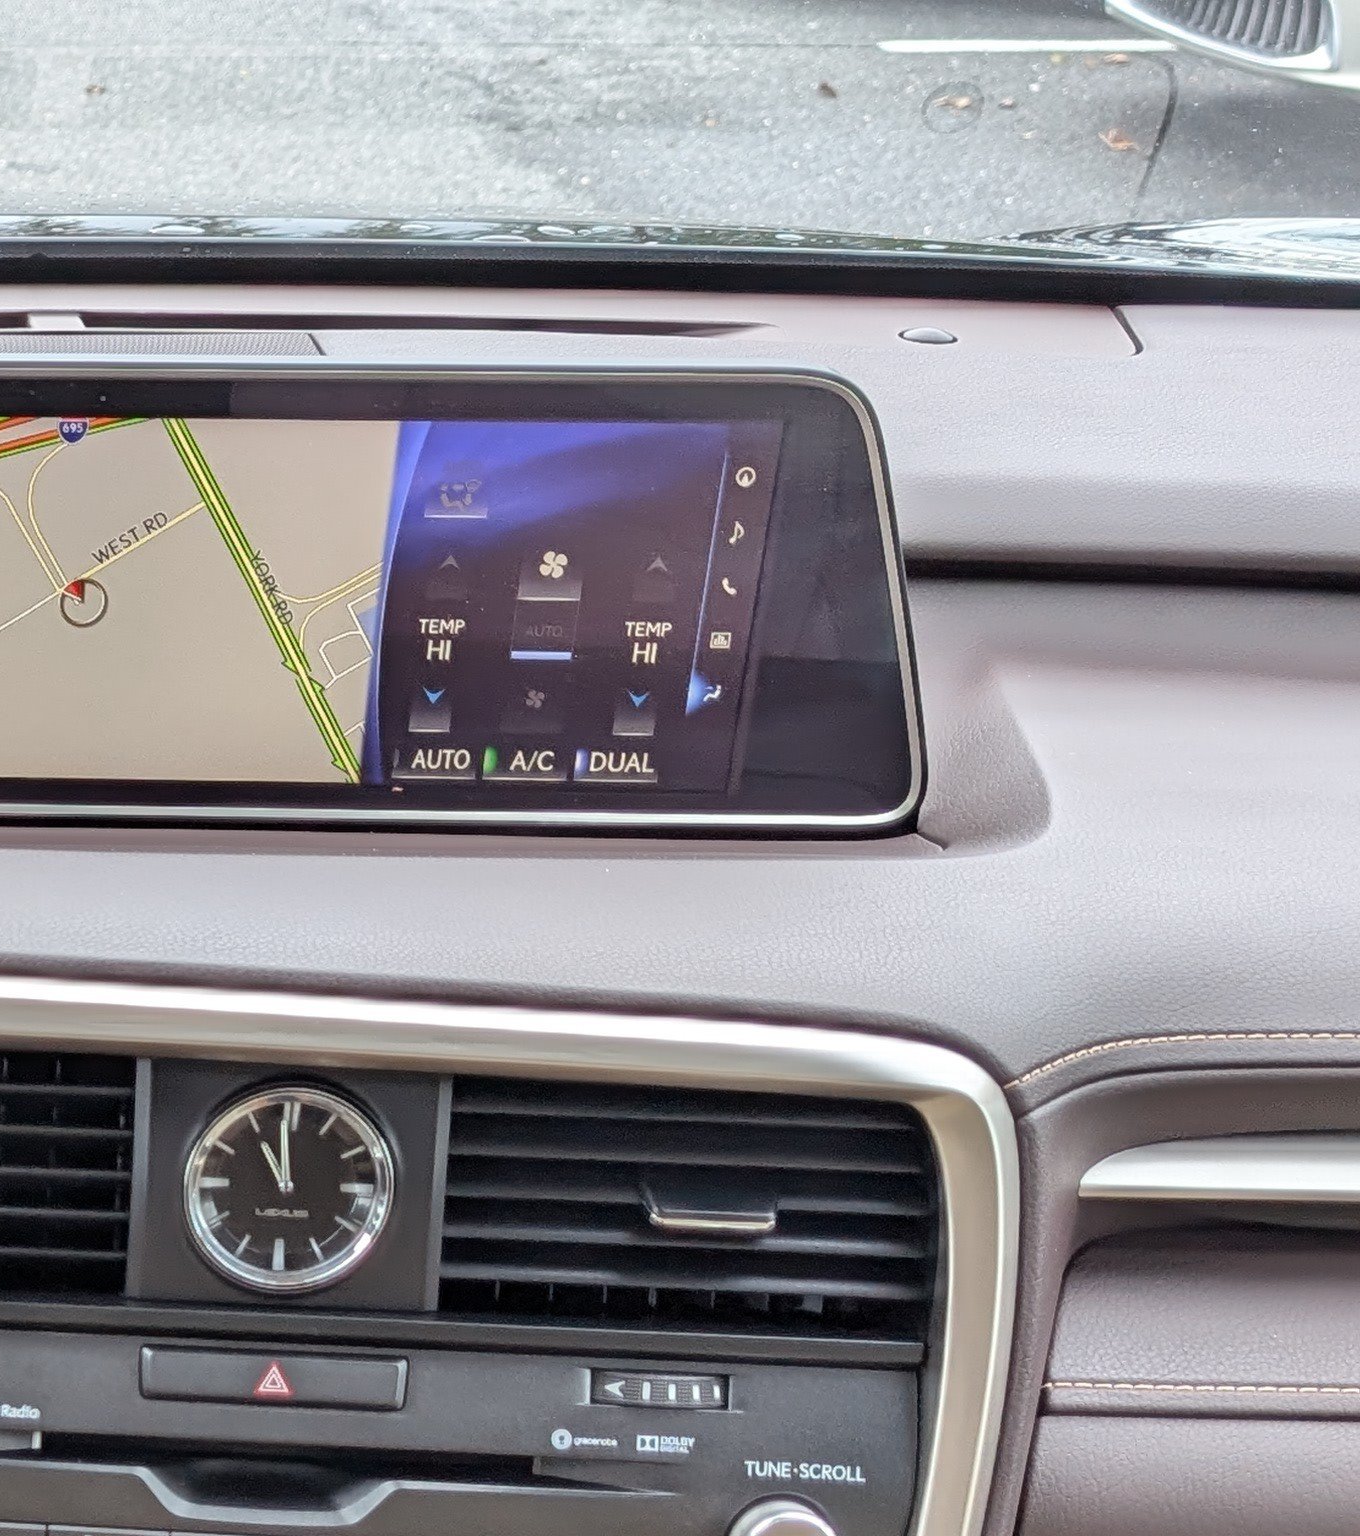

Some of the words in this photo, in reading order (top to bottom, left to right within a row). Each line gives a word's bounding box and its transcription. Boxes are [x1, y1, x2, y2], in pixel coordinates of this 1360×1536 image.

[62, 422, 83, 435] 695
[91, 526, 143, 566] WEST
[138, 511, 169, 538] RD
[418, 617, 466, 637] TEMP
[524, 624, 564, 638] AUTO
[624, 620, 673, 639] TEMP
[427, 639, 452, 662] HI
[632, 642, 658, 665] HI
[410, 749, 471, 772] AUTO
[509, 751, 555, 773] A/C
[589, 751, 655, 774] DUAL
[0, 1403, 41, 1419] Radio
[660, 1435, 696, 1448] DOLBY
